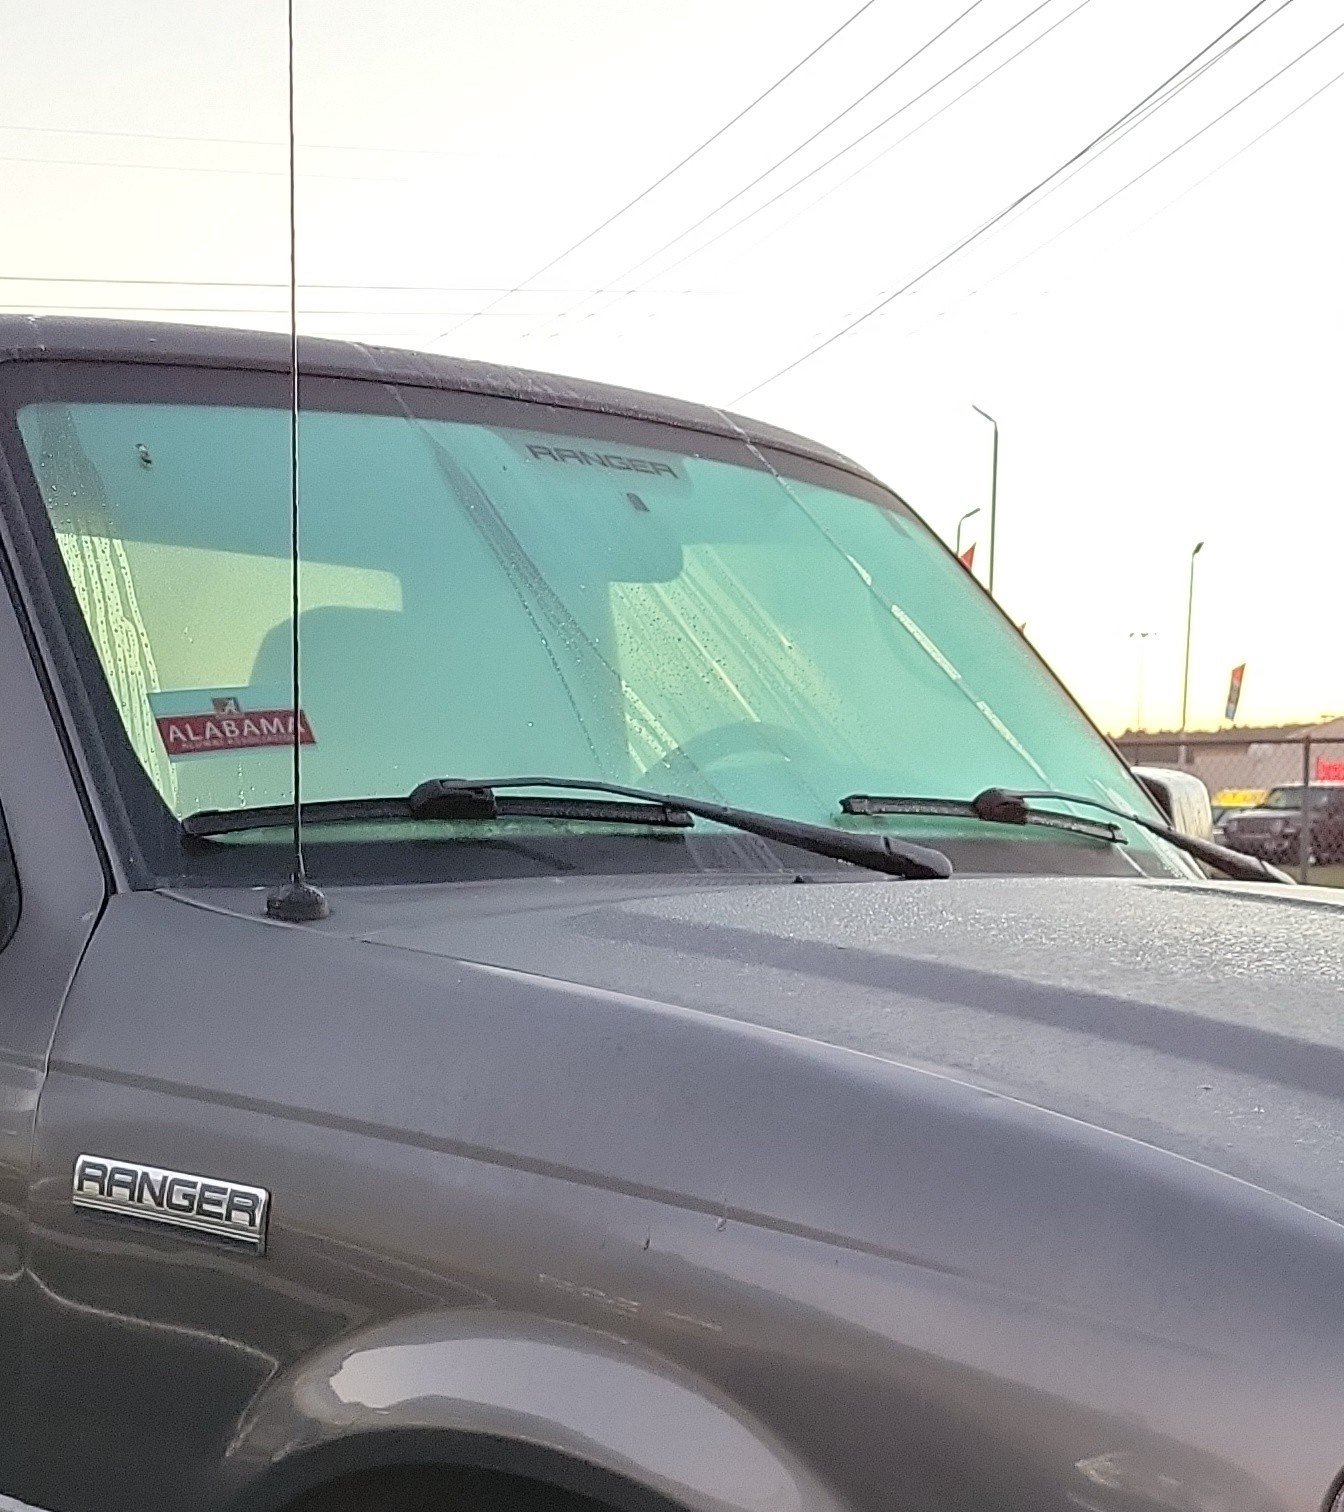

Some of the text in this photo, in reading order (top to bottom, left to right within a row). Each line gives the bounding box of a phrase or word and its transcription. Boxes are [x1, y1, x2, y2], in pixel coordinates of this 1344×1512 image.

[525, 444, 679, 479] RANGER
[169, 717, 305, 743] ALABAMA
[76, 1160, 261, 1227] RANGER
